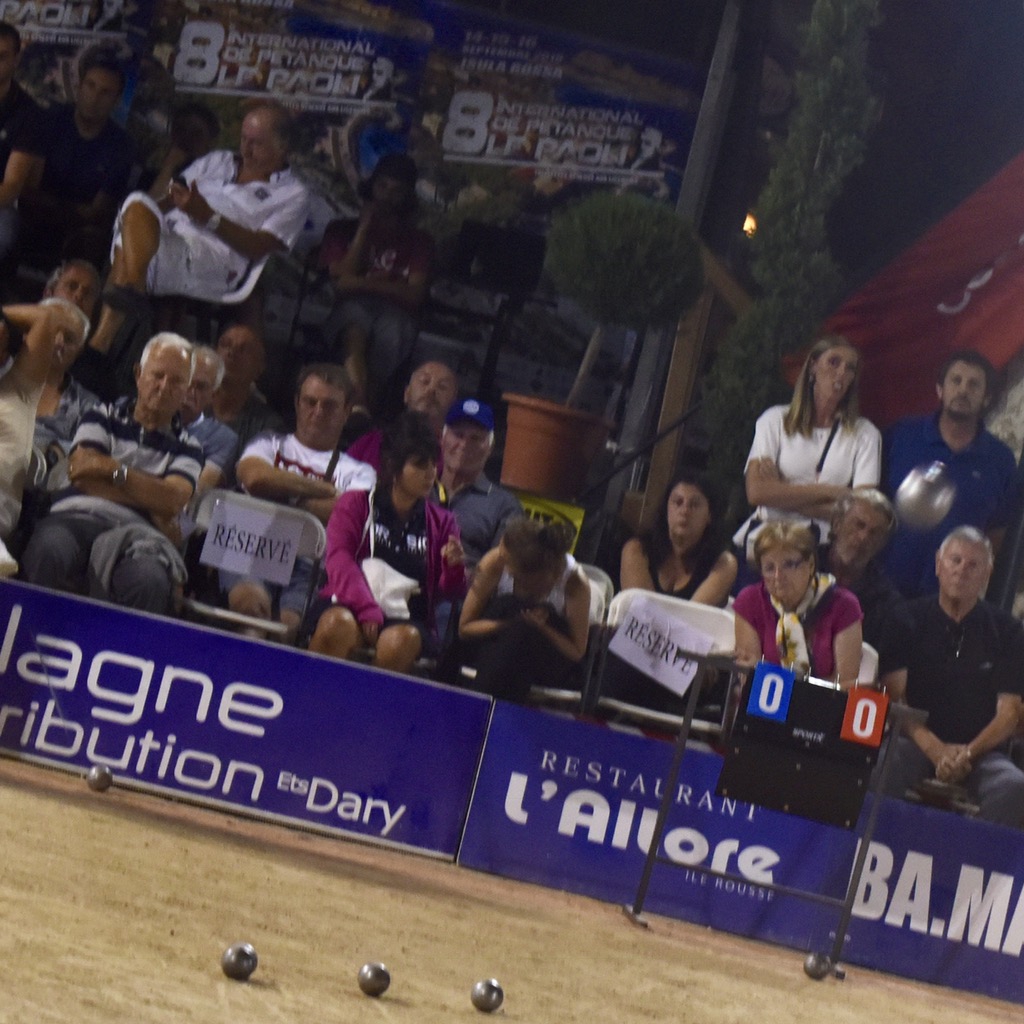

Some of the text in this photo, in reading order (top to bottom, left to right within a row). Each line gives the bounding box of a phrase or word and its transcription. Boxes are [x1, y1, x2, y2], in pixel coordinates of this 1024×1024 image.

[174, 20, 225, 85] 8
[227, 31, 375, 55] INTERNATIONAL
[443, 90, 494, 155] 8
[0, 604, 284, 737] lagne
[759, 673, 877, 739] 0 0
[0, 699, 264, 801] ribution
[305, 776, 406, 836] Dary
[541, 751, 761, 821] RESTAURANT
[685, 869, 707, 885] ILE
